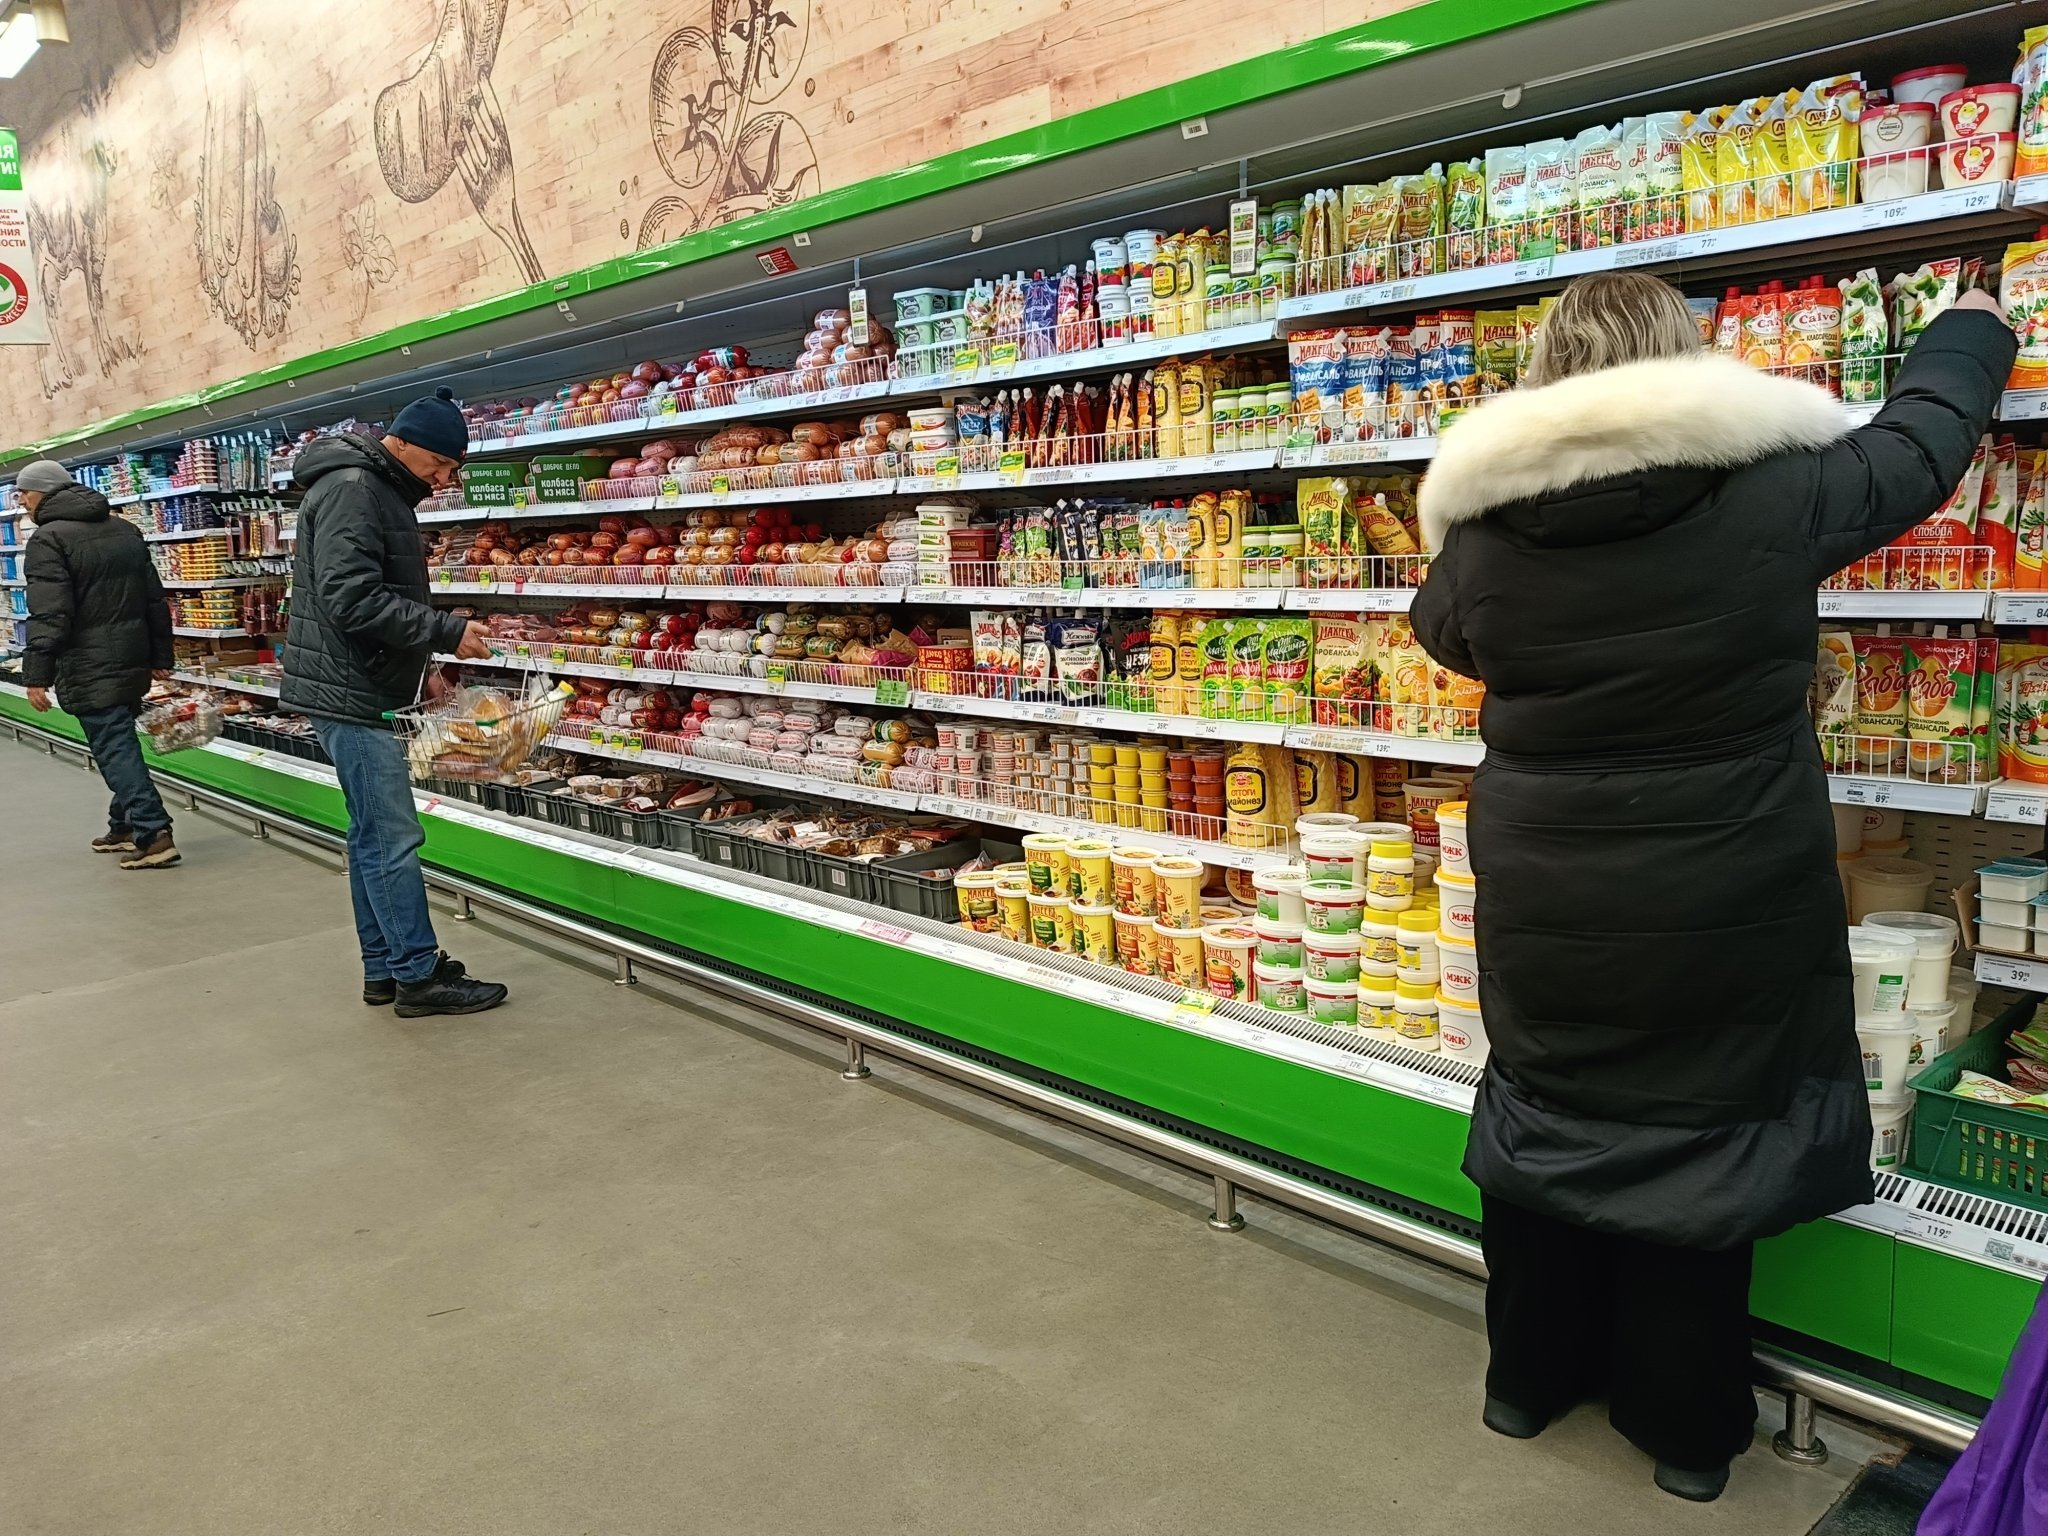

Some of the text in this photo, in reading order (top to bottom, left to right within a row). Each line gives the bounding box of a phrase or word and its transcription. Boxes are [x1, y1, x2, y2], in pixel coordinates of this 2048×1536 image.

[1964, 196, 1984, 207] 129
[1884, 208, 1900, 218] 109
[0, 239, 26, 247] ОСТИ
[1800, 310, 1838, 324] Calvé
[1913, 526, 1953, 537] СЛОБОДА
[1820, 602, 1836, 611] 139
[1875, 795, 1886, 803] 89
[2018, 806, 2032, 815] 84
[1446, 972, 1472, 984] МЖК
[2011, 970, 2024, 980] 39
[1443, 1032, 1466, 1045] МЖК
[1926, 1225, 1944, 1237] 119
